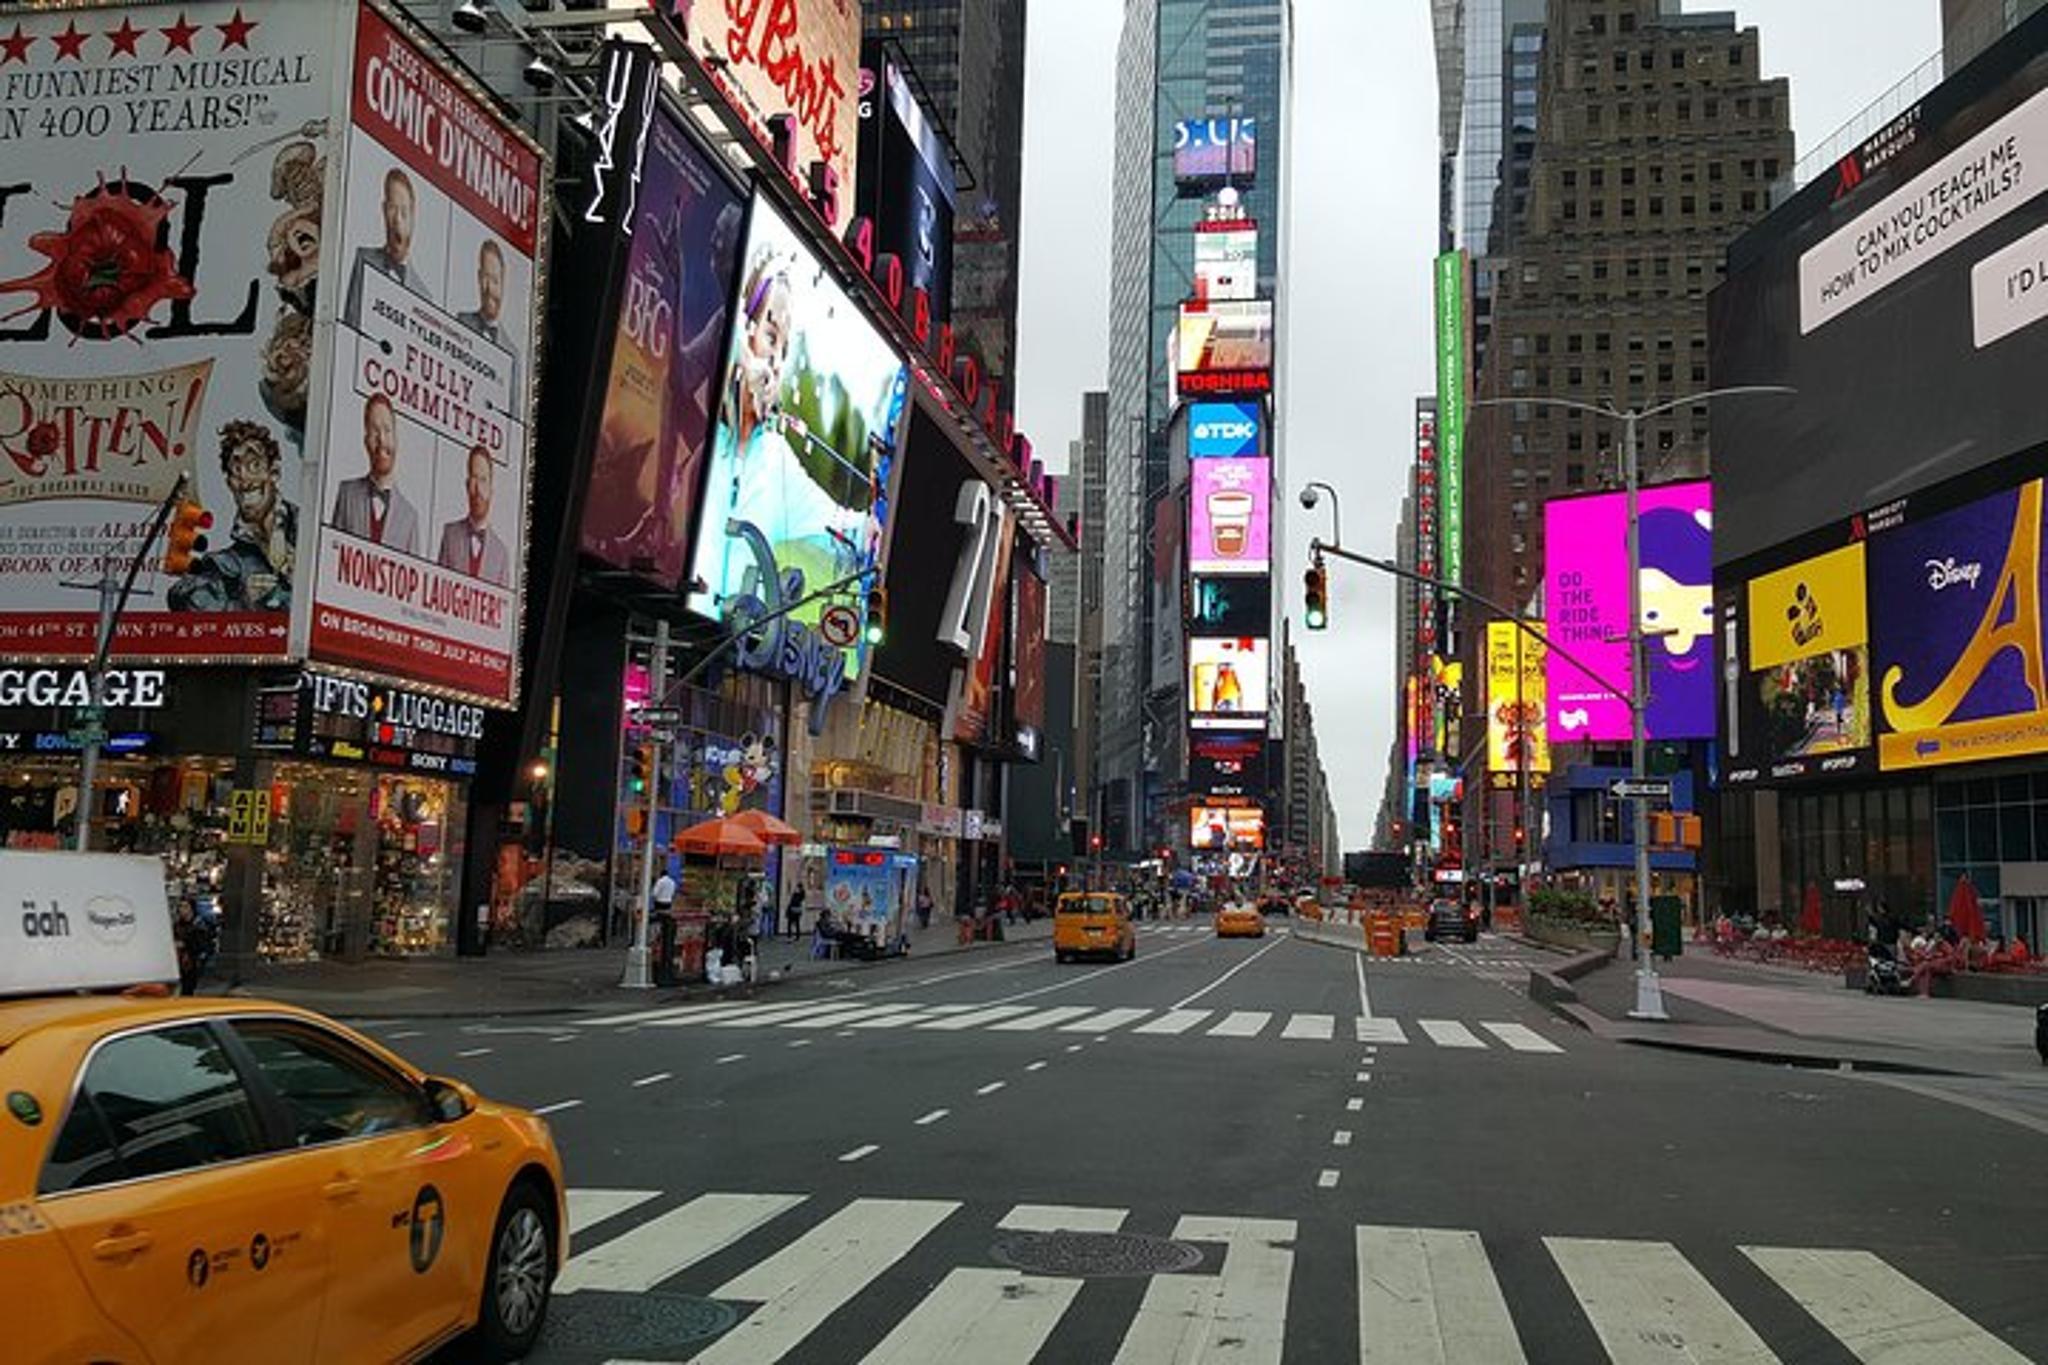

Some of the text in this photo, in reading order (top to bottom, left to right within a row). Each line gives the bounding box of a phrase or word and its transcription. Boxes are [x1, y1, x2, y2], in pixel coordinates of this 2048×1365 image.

[5, 56, 312, 101] FUNNIEST MUSICAL
[39, 103, 111, 138] 400
[1864, 104, 1922, 156] MARRIOTT
[366, 56, 436, 155] COMIC
[439, 116, 534, 231] DYNAMO!
[1856, 135, 2018, 257] CAN YOU TEACH ME
[1820, 161, 2024, 304] HOW TO MIX COCKTAILS?
[624, 273, 672, 358] BFG
[372, 298, 497, 382] JESSE TYLER FERGUSON
[3, 374, 175, 401] SOMETHING
[405, 343, 473, 403] FULLY
[1180, 372, 1269, 390] TOSHIBA
[363, 357, 504, 451] COMMITTED
[1210, 422, 1254, 438] TDK
[1558, 572, 1582, 587] DO
[1925, 557, 1982, 591] Disney
[1558, 607, 1599, 624] RIDE
[1562, 590, 1594, 605] THE
[222, 623, 265, 637] AVES
[319, 611, 340, 631] ON
[343, 614, 410, 646] BROADWAY
[412, 632, 442, 656] THRU
[442, 640, 465, 661] JULY
[483, 654, 508, 674] ONLY
[1562, 625, 1615, 642] THING
[387, 690, 485, 739] LUGGAGE
[411, 753, 447, 770] SONY
[231, 792, 247, 835] ATM
